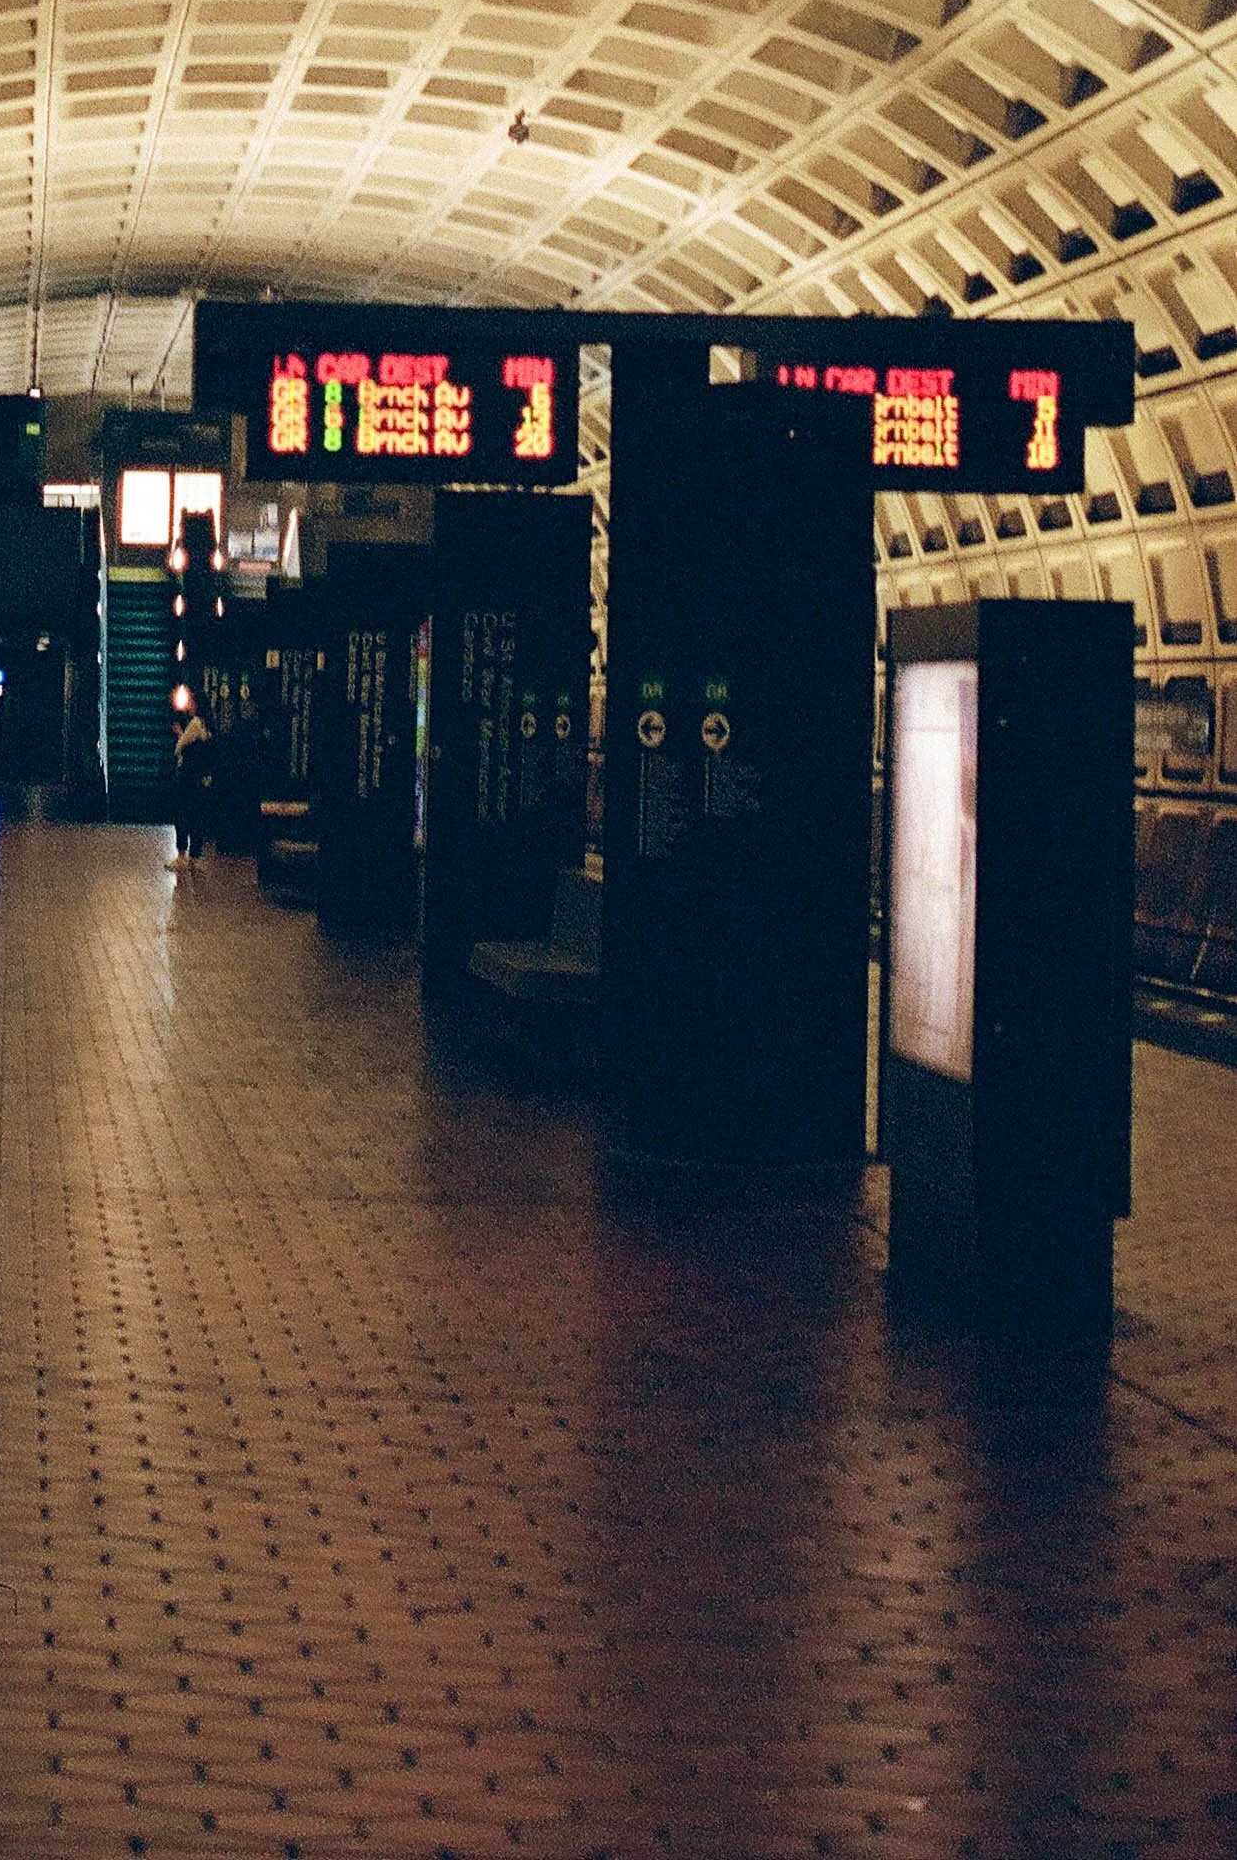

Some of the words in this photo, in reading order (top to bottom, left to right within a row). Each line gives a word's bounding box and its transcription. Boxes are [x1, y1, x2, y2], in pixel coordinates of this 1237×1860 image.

[316, 352, 371, 384] CAR
[379, 353, 450, 385] DEST
[502, 356, 555, 389] MIN
[886, 368, 954, 396] DEST
[1009, 370, 1059, 400] MIN
[271, 378, 308, 403] GR
[433, 380, 472, 408] Av
[271, 402, 308, 428] GR
[433, 405, 472, 431] Av
[521, 406, 552, 431] 13
[1033, 419, 1055, 444] 11
[271, 426, 308, 453] GR
[323, 427, 342, 452] 8
[358, 427, 430, 455] Brnch
[433, 430, 472, 456] Av
[514, 428, 553, 457] 20
